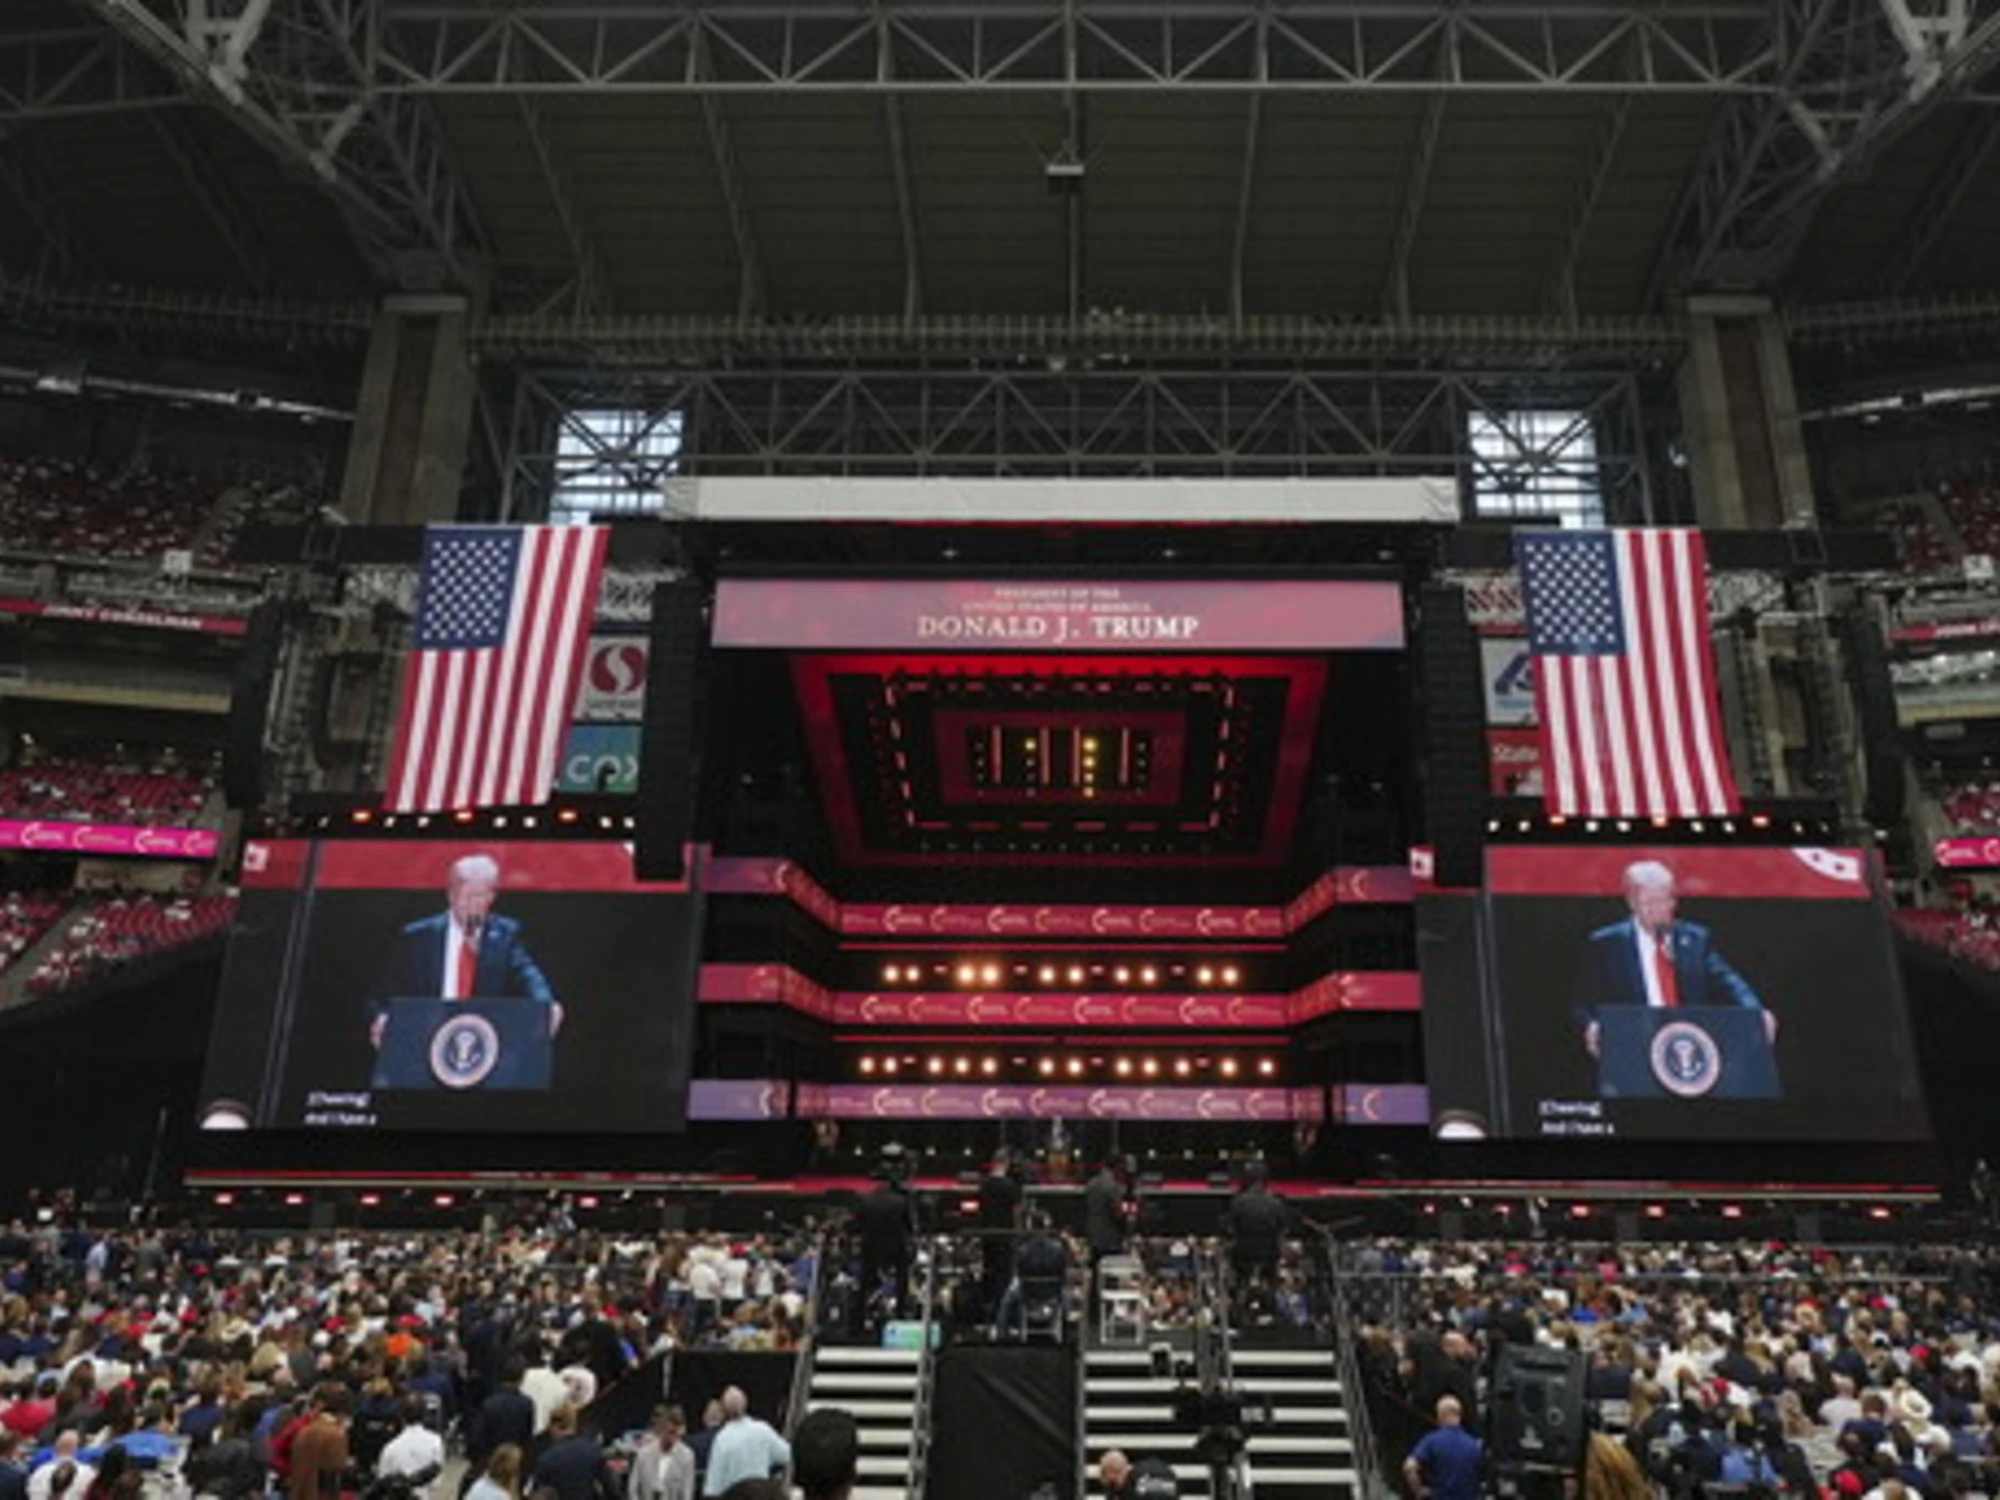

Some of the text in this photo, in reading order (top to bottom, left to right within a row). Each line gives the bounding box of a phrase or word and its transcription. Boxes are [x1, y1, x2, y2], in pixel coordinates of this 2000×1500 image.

[917, 615, 1199, 643] DONALD J. TRUMP
